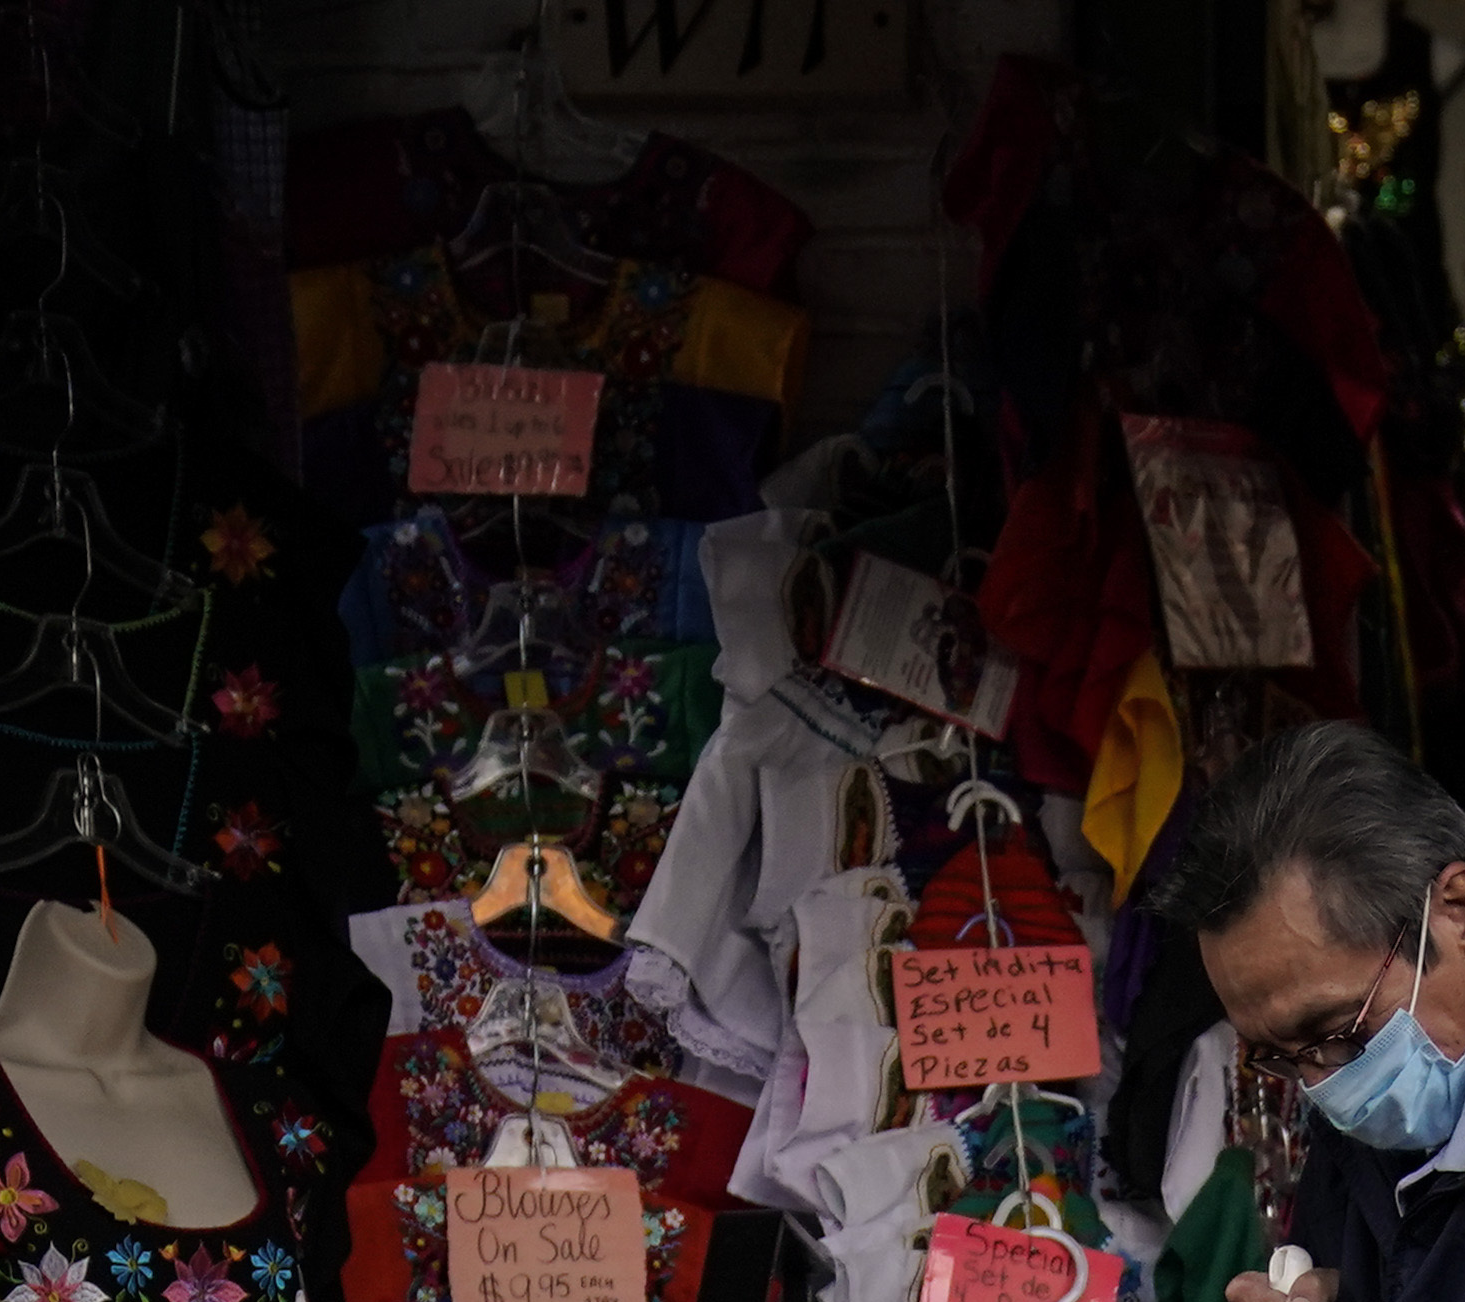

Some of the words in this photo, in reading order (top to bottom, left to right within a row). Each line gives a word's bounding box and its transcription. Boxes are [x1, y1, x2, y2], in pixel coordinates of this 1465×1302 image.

[903, 956, 959, 987] Set
[986, 1017, 1012, 1038] de
[1030, 1013, 1051, 1049] 4
[910, 1054, 1031, 1085] Piezas
[454, 1170, 611, 1224] Blouses
[477, 1227, 518, 1265] On
[539, 1222, 606, 1265] Sale
[965, 1222, 1077, 1277] Special
[964, 1259, 1009, 1290] Set
[1021, 1275, 1051, 1300] de
